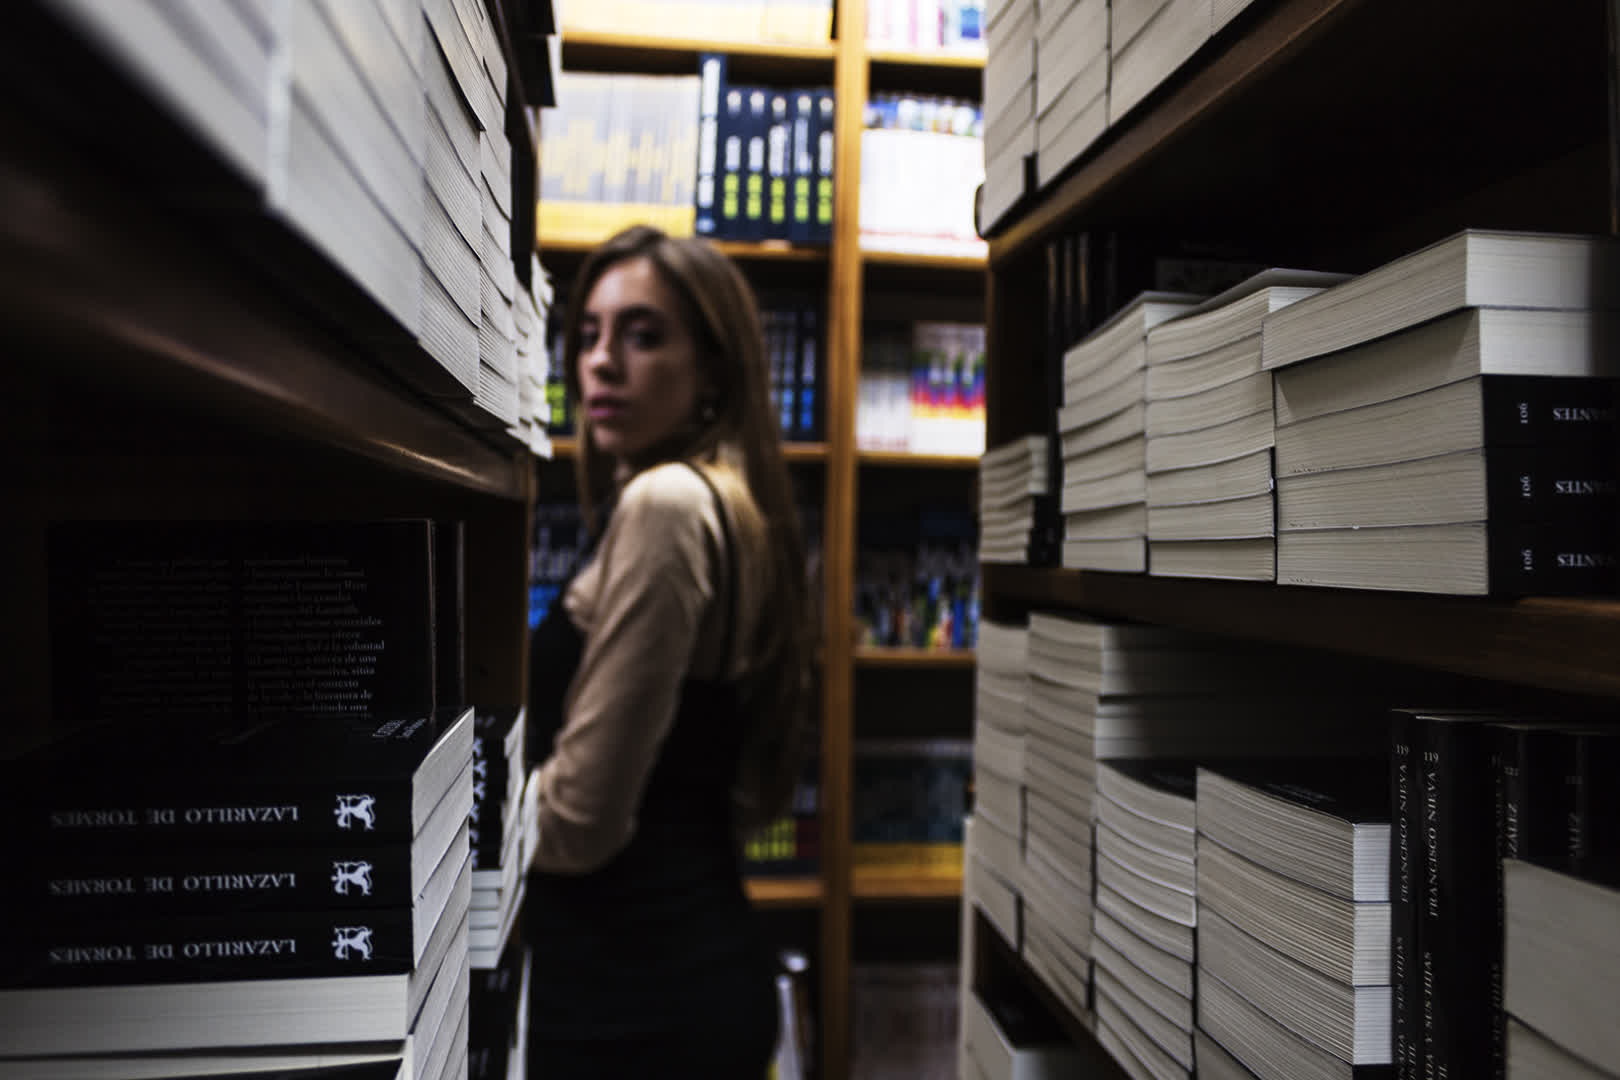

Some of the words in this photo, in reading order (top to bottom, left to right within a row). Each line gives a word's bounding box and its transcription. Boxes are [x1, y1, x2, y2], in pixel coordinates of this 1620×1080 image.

[1424, 751, 1439, 763] 119
[1398, 764, 1408, 811] NIEVA
[1426, 772, 1437, 821] NIEVA
[49, 810, 138, 829] TORMES
[146, 808, 177, 827] DE
[183, 805, 299, 825] LAZARILLO
[1399, 817, 1409, 903] FRANCISCO
[1427, 827, 1438, 917] FRANCISCO
[49, 878, 138, 897] TORMES
[145, 876, 175, 895] DE
[182, 872, 298, 892] LAZARILLO
[49, 944, 138, 963] TORMES
[145, 942, 175, 961] DE
[183, 938, 298, 960] LAZARILLO
